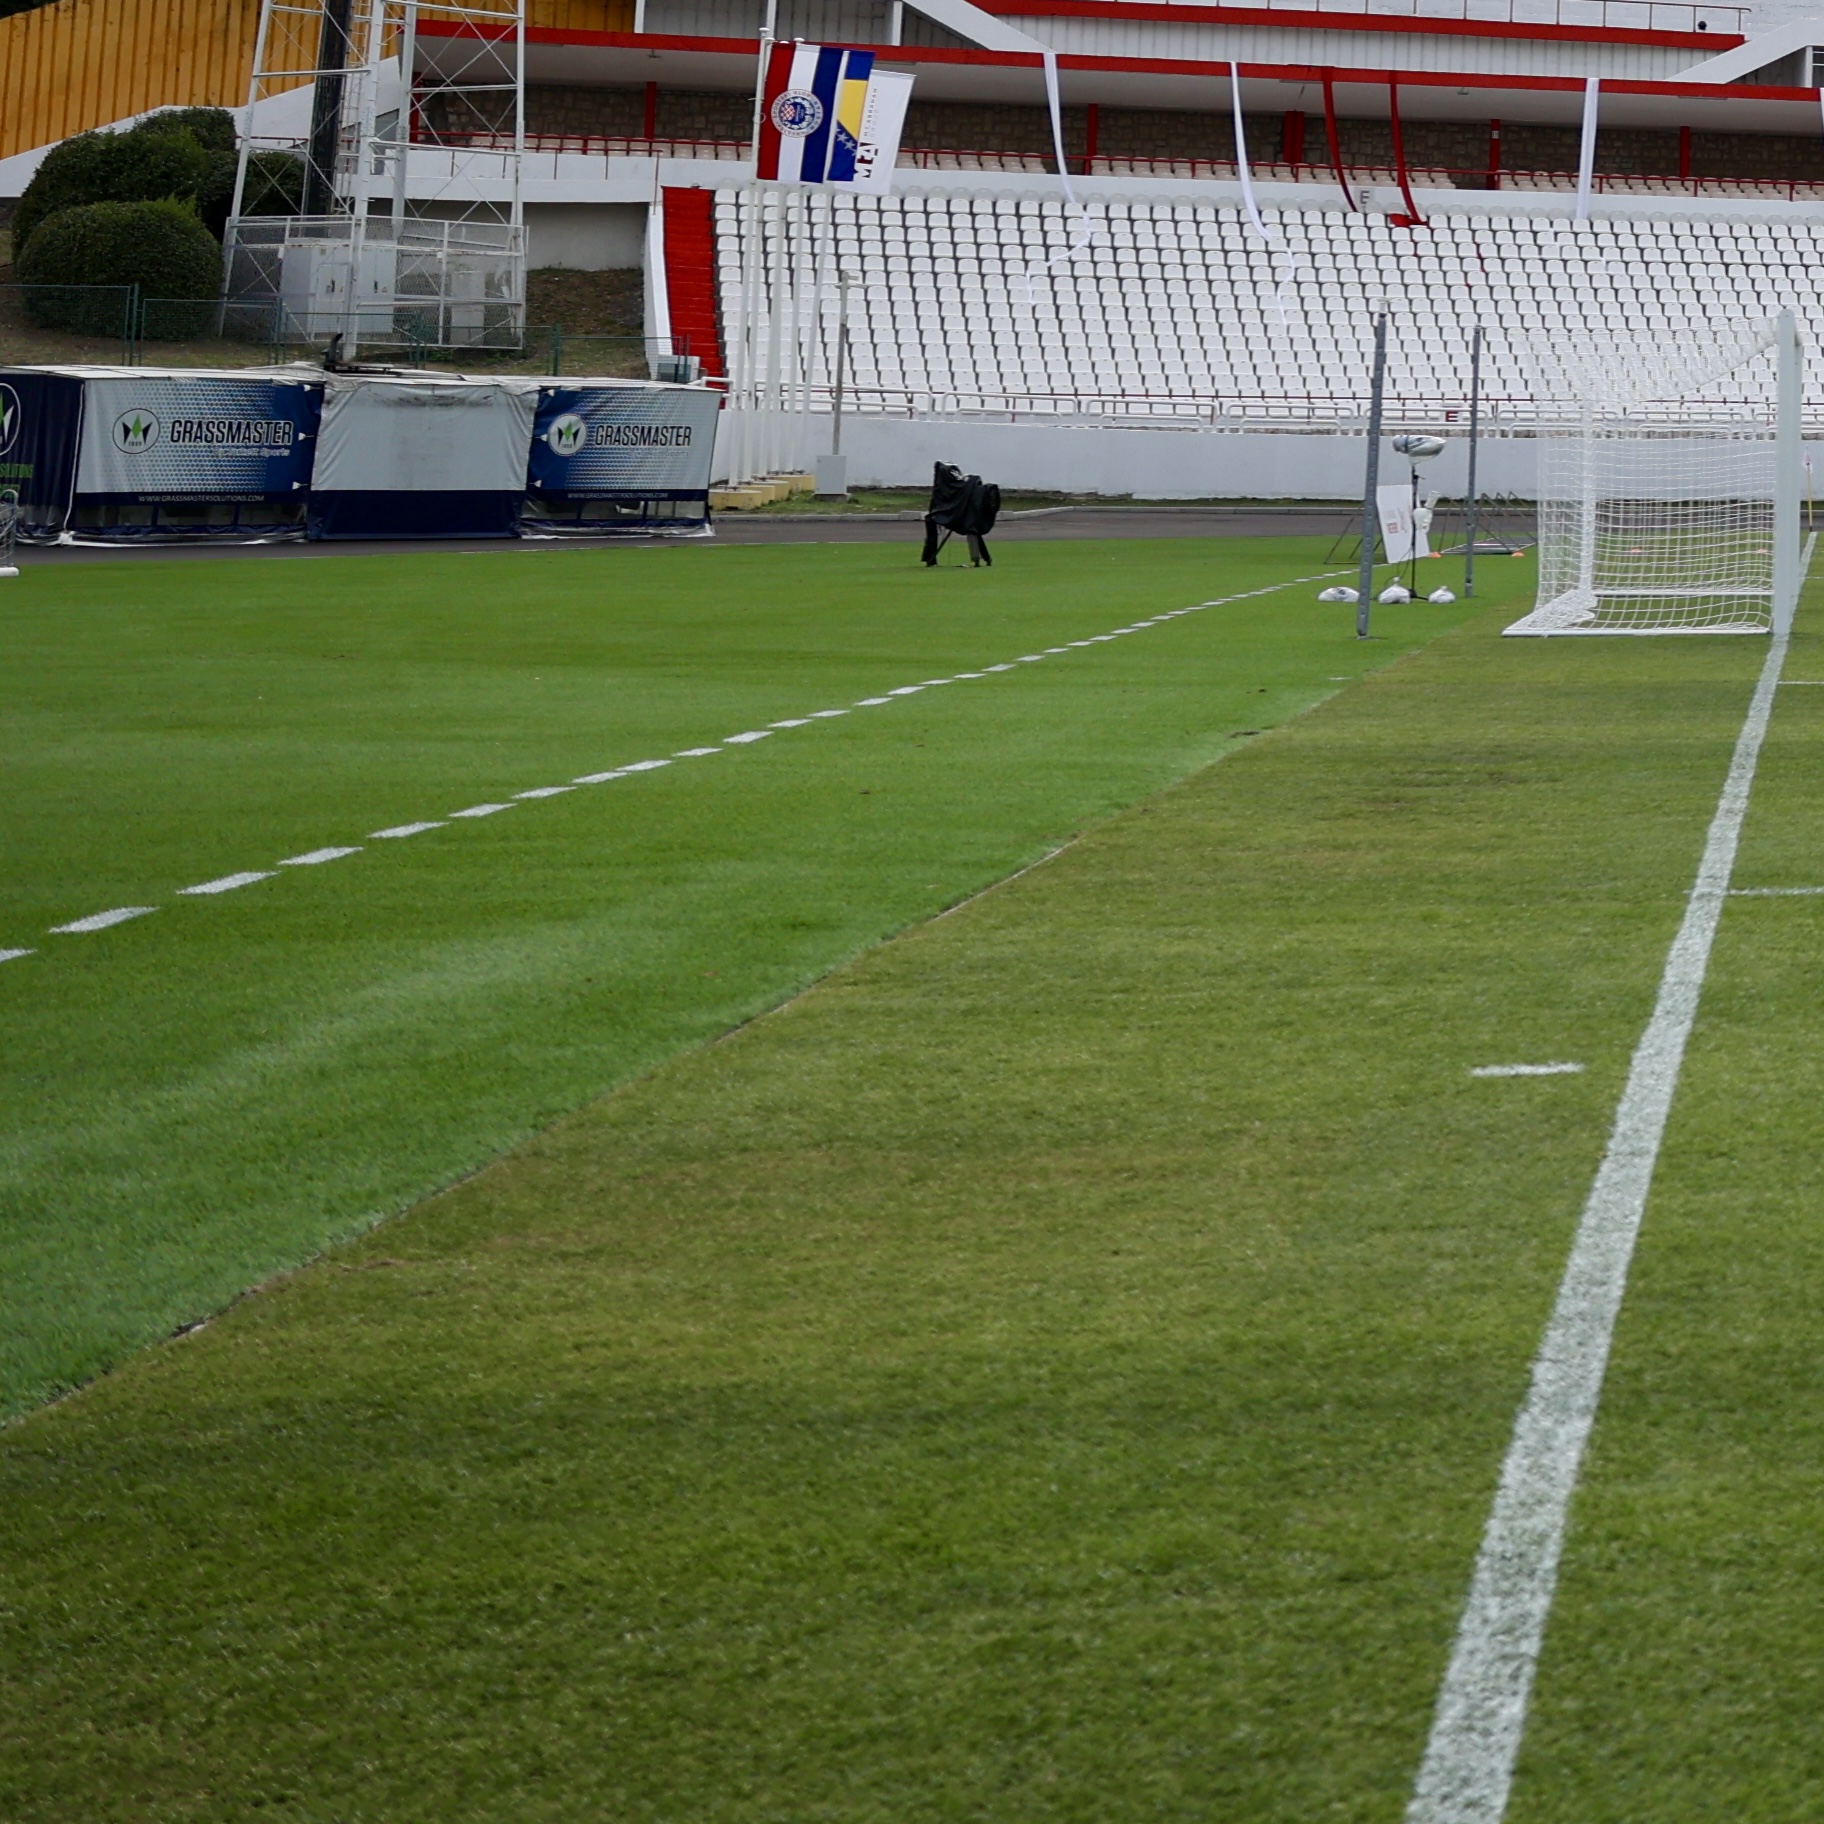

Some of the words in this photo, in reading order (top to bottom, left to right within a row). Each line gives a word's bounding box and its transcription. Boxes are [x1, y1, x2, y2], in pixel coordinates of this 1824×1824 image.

[1360, 189, 1370, 204] E
[169, 419, 294, 445] GRASSMASTER
[594, 425, 692, 447] GRASSMASTER
